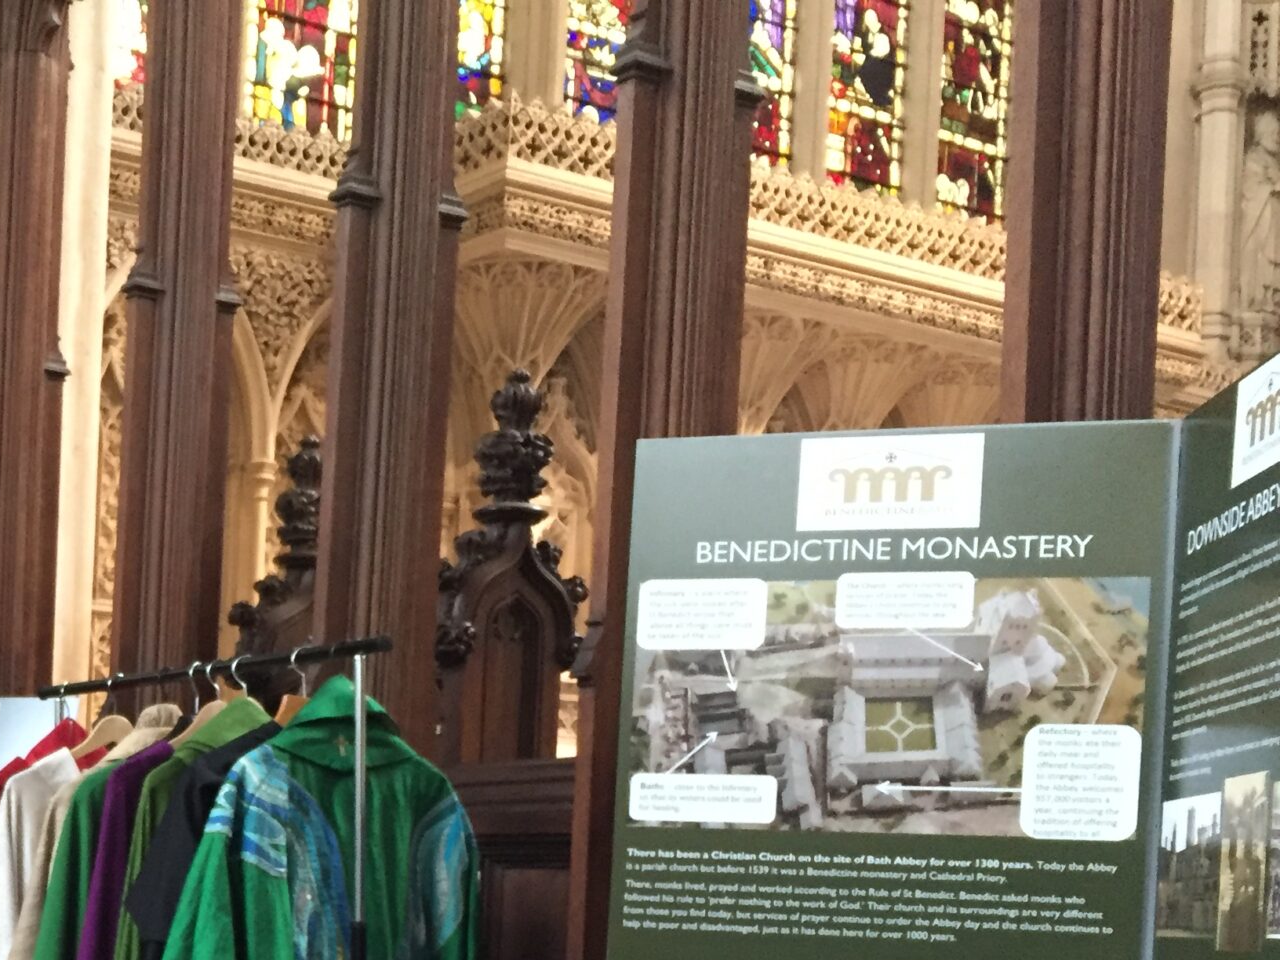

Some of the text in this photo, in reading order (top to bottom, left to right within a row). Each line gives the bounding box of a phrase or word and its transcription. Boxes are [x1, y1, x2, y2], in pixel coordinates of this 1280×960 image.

[1187, 500, 1246, 555] DOWNSIDE
[696, 532, 1094, 564] BENEDICTINE MONASTERY
[626, 848, 656, 858] There
[658, 849, 674, 858] has
[676, 850, 700, 859] been
[711, 851, 756, 861] Christian
[759, 852, 795, 862] Church
[814, 854, 830, 863] the
[833, 855, 851, 864] site
[867, 856, 892, 865] Bath
[894, 857, 927, 869] Abbey
[930, 858, 944, 867] for
[948, 860, 971, 868] over
[976, 859, 999, 869] 1300
[1002, 862, 1033, 872] years.
[1036, 861, 1066, 873] Today
[1068, 862, 1084, 872] the
[1086, 863, 1118, 875] Abbey
[642, 862, 667, 874] parish
[669, 863, 698, 872] church
[700, 864, 715, 873] but
[717, 865, 744, 874] before
[749, 866, 768, 875] 1539
[807, 868, 858, 878] Benedictine
[860, 869, 907, 882] monastery
[910, 871, 926, 880] and
[930, 872, 973, 881] Cathedral
[655, 880, 682, 889] monks
[708, 882, 738, 894] prayed
[741, 883, 756, 892] and
[759, 884, 792, 894] worked
[794, 885, 836, 898] according
[852, 887, 865, 897] the
[869, 888, 888, 897] Rule
[960, 892, 999, 902] Benedict
[1002, 893, 1028, 903] asked
[1030, 894, 1061, 904] monks
[1064, 896, 1085, 905] who
[624, 905, 644, 915] from
[646, 906, 669, 916] those
[672, 909, 688, 919] you
[736, 910, 751, 919] but
[754, 911, 787, 921] services
[802, 915, 830, 925] prayer
[833, 914, 871, 924] continue
[886, 916, 911, 926] order
[915, 918, 929, 927] the
[932, 918, 960, 931] Abbey
[963, 920, 979, 931] day
[983, 920, 999, 930] and
[1002, 921, 1017, 930] the
[1020, 922, 1051, 932] church
[1054, 923, 1099, 934] continues
[786, 899, 799, 908] the
[802, 900, 825, 909] work
[868, 902, 891, 912] Their
[894, 903, 924, 913] church
[927, 904, 943, 914] and
[960, 906, 1019, 919] surroundings
[1040, 911, 1059, 921] very
[1063, 910, 1103, 920] different
[623, 918, 640, 930] help
[642, 919, 656, 929] the
[658, 922, 679, 932] poor
[682, 921, 697, 930] and
[802, 926, 815, 935] has
[818, 927, 840, 936] done
[842, 928, 863, 937] here
[866, 929, 879, 938] for
[906, 931, 927, 940] 1000
